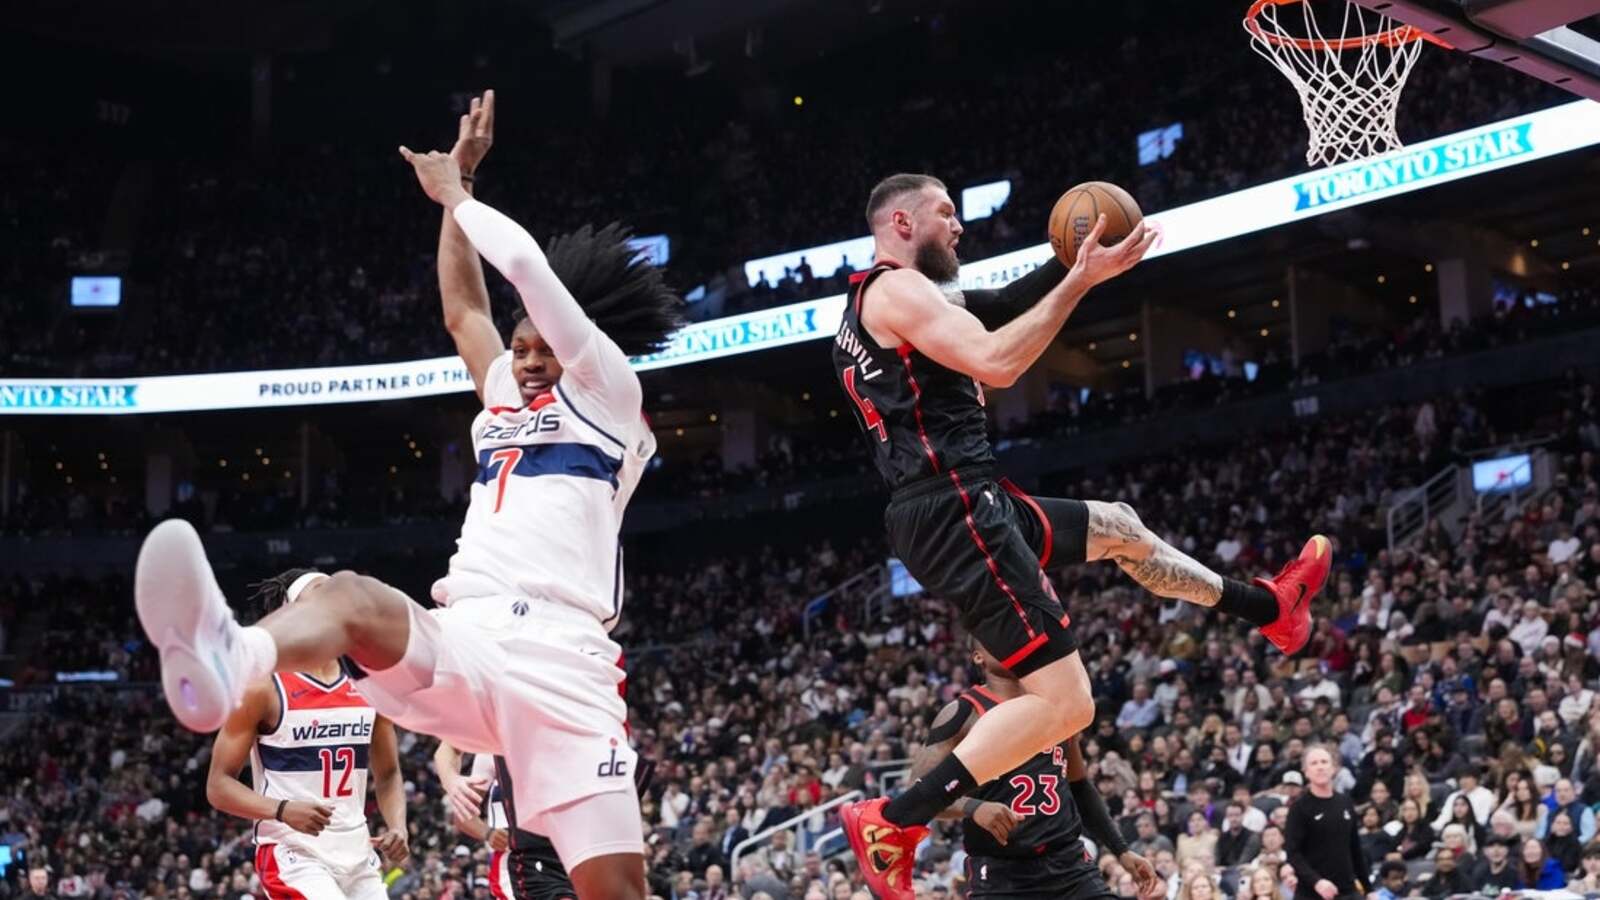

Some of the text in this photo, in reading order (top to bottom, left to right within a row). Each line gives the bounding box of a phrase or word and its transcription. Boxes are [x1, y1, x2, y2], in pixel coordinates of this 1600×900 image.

[1302, 127, 1526, 207] TORONTO STAR
[747, 308, 811, 343] STAR
[60, 386, 128, 407] STAR
[259, 381, 323, 397] PROUD
[327, 374, 411, 394] PARTNER
[416, 372, 436, 387] OF
[842, 365, 887, 442] 4
[488, 447, 524, 514] 7
[292, 715, 372, 741] wizards
[319, 747, 355, 798] 12
[598, 737, 627, 777] dc
[1009, 774, 1061, 816] 23
